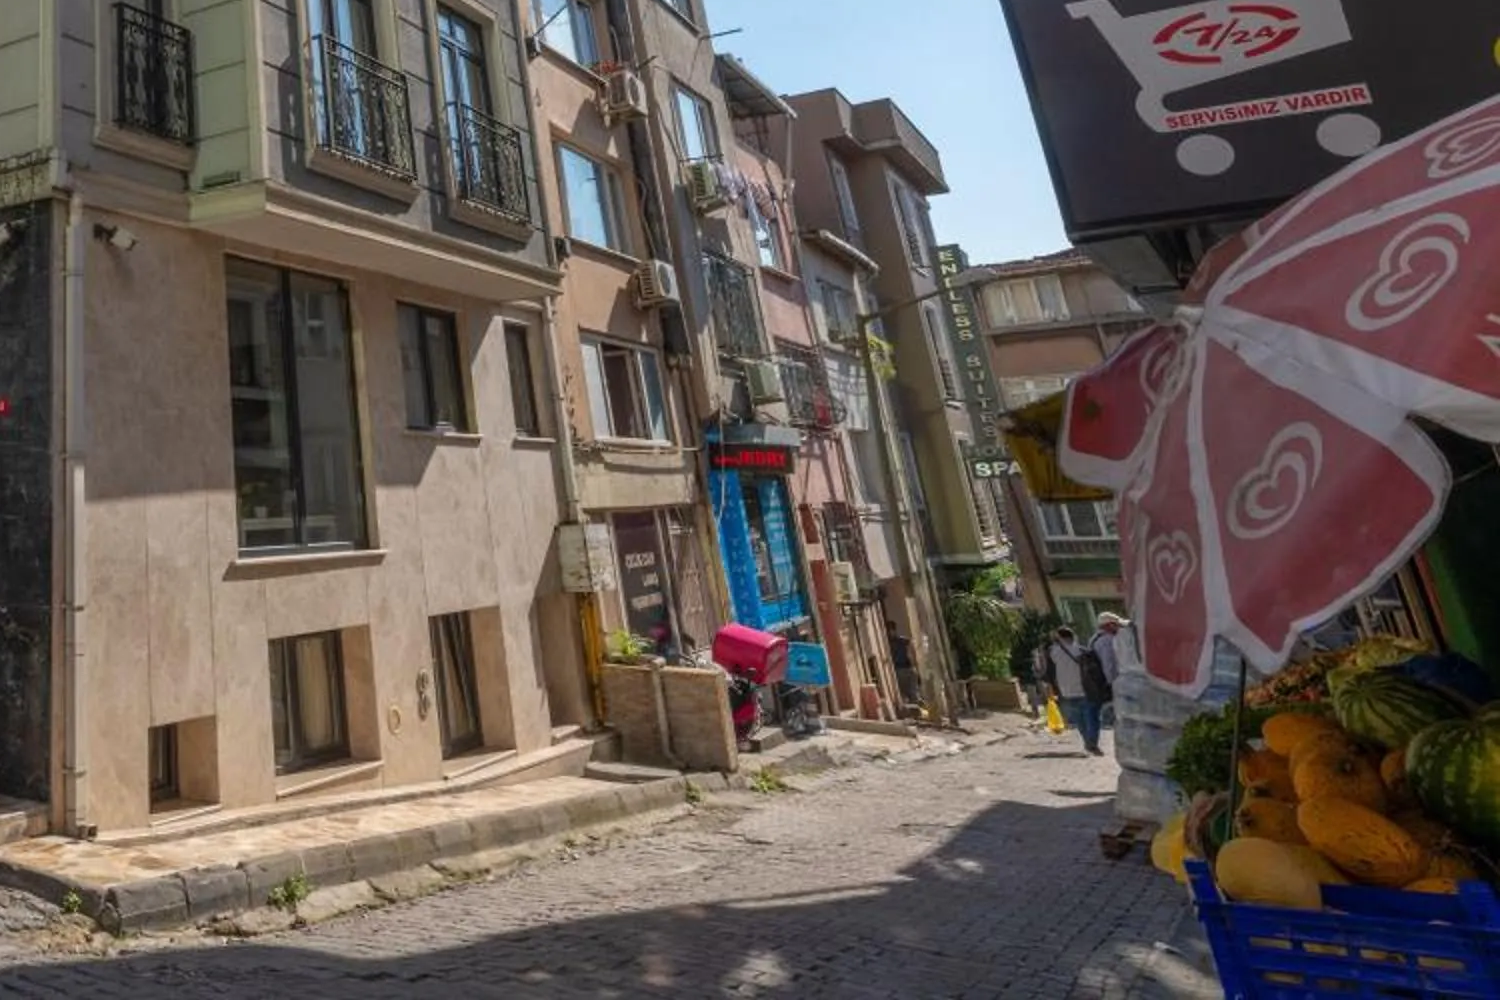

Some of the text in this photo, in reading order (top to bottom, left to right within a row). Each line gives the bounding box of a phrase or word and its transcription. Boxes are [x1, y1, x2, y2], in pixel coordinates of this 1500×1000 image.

[1182, 18, 1276, 52] 7/24
[1283, 85, 1368, 112] VARDIR
[974, 460, 1023, 477] SPA
